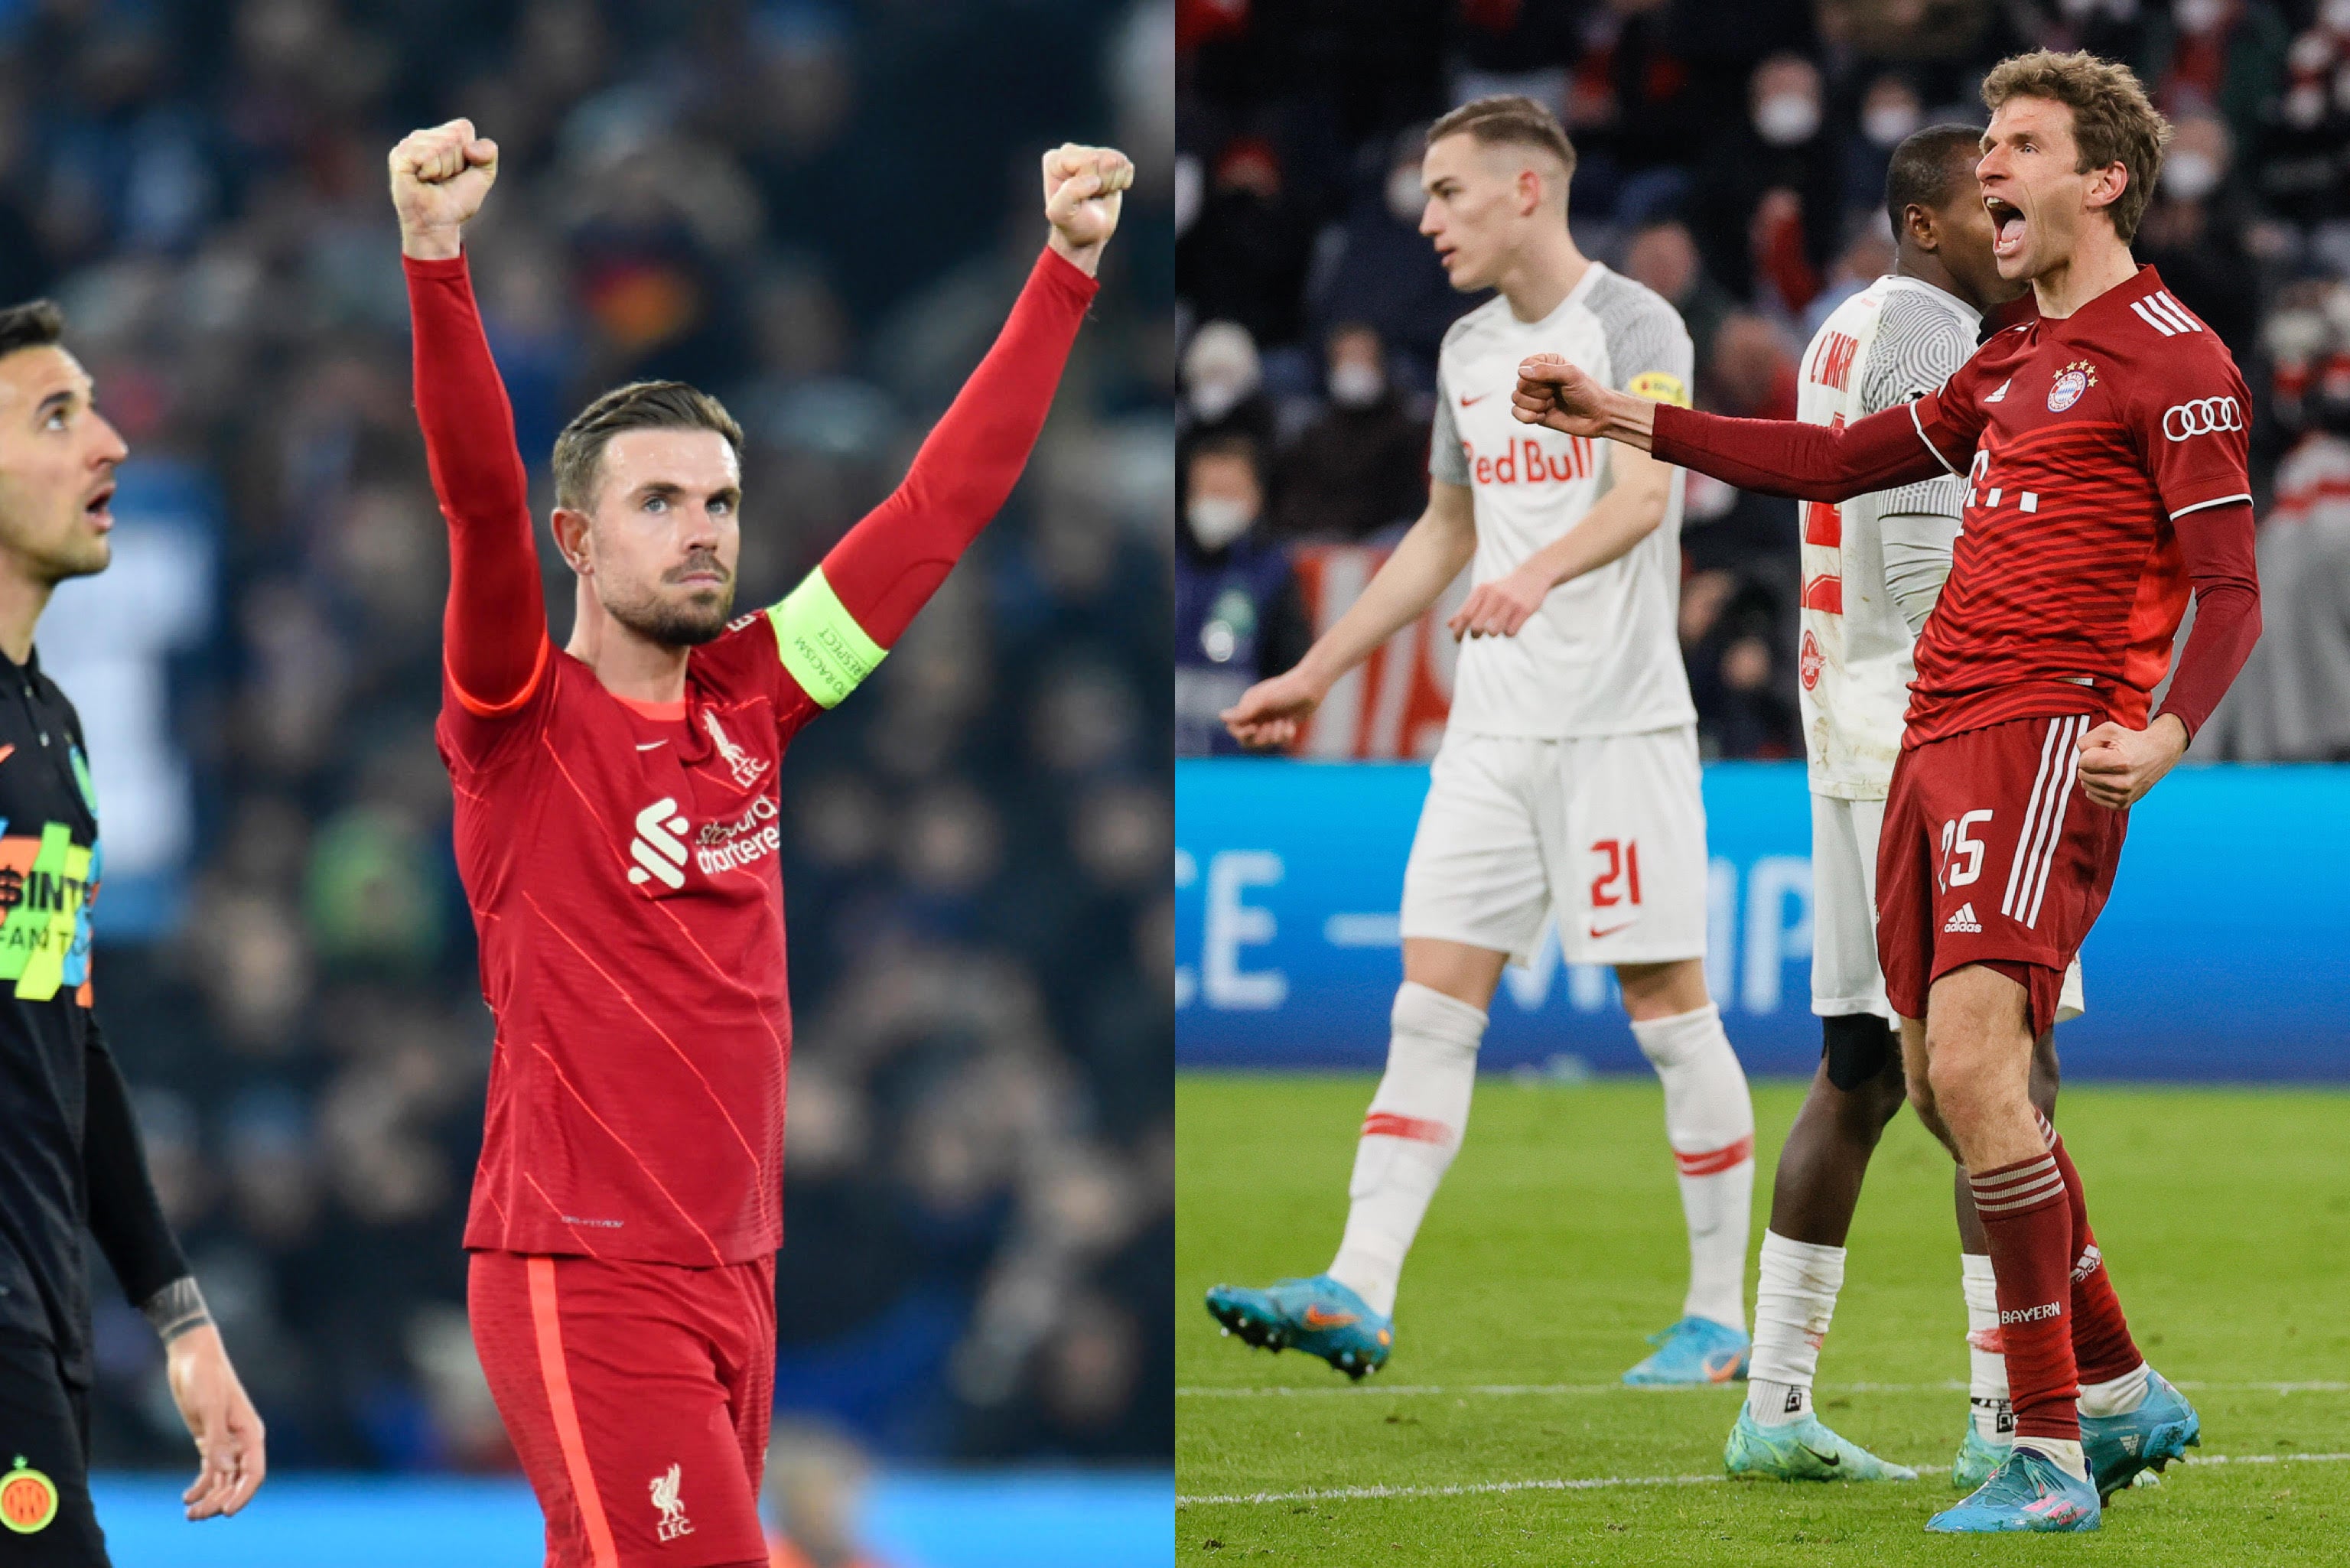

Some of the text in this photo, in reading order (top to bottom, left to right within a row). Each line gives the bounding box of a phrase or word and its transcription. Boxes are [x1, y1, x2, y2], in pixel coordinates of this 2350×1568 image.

[1523, 433, 1593, 483] Bull
[1590, 838, 1642, 908] 21
[1938, 808, 1994, 896] 25
[0, 926, 49, 951] AN
[1175, 847, 1288, 1011] E
[1944, 920, 1983, 933] adidas
[2001, 1300, 2061, 1325] BAYERN
